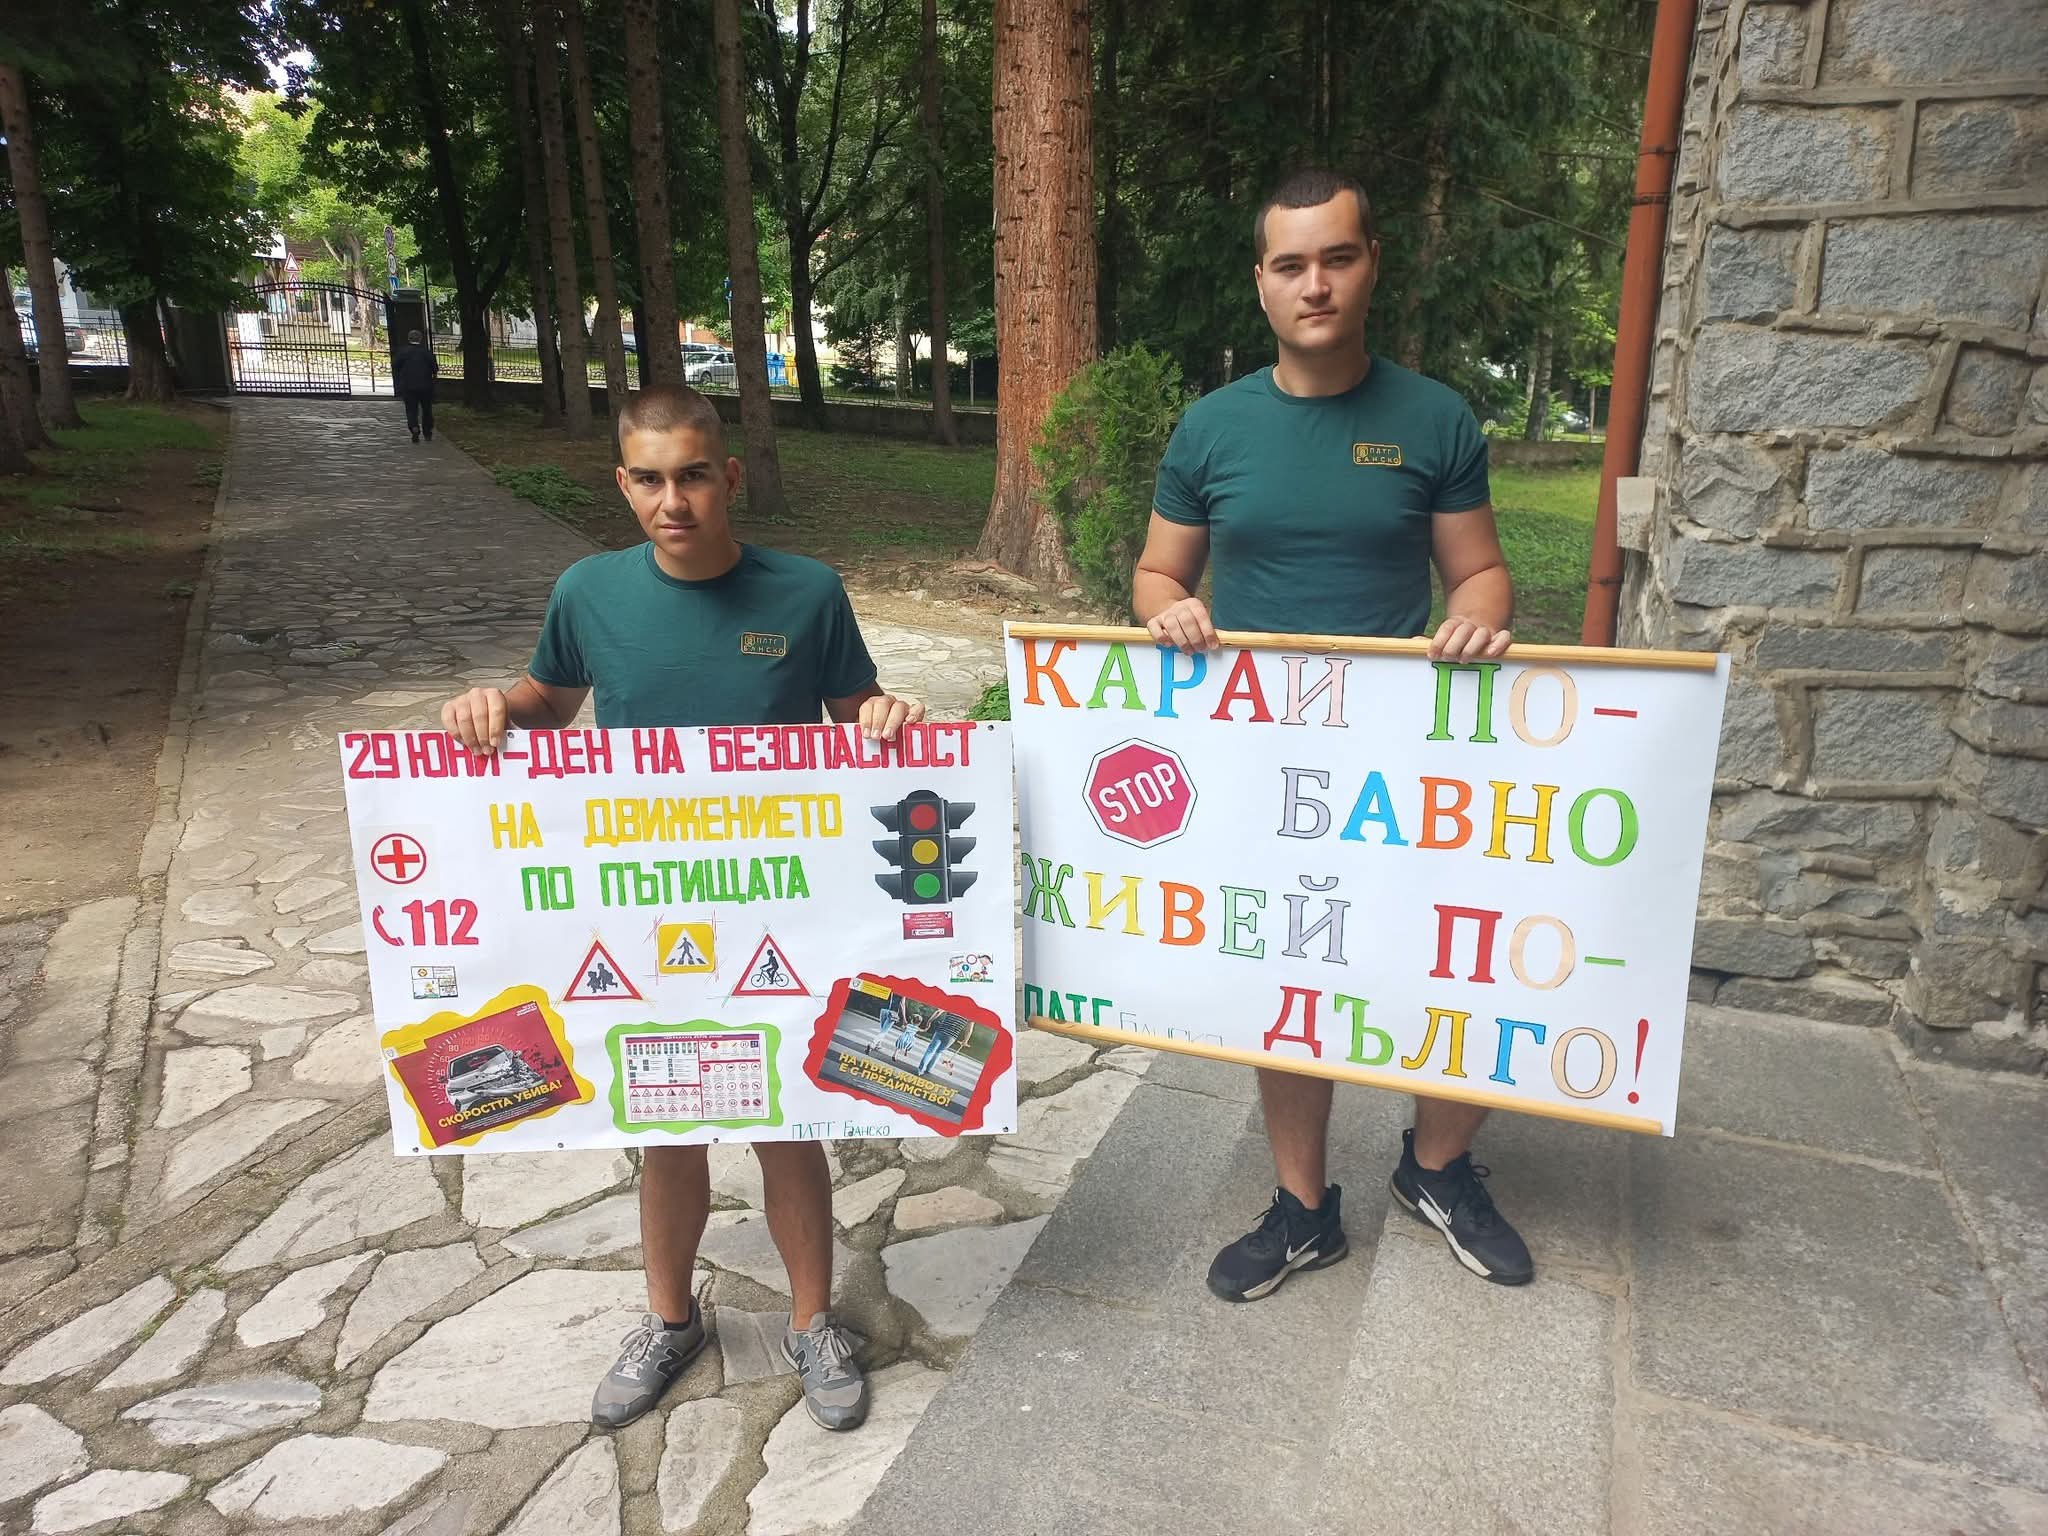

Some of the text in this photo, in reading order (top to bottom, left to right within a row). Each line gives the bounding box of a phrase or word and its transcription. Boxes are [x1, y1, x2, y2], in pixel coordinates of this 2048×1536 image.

[1356, 456, 1399, 464] БАНСКО
[743, 646, 783, 654] БАНСКО
[344, 733, 400, 779] 29
[632, 728, 685, 775] НА
[707, 721, 977, 773] БЕЗОПАСНОСТ
[488, 793, 843, 849] НА ДВИЖЕНИЕТО
[1098, 762, 1179, 824] STOP
[1276, 766, 1639, 867] БАВНО
[521, 855, 811, 911] ПО ПЪТИЩАТА
[1021, 852, 1351, 966] ЖИВЕЙ
[402, 898, 479, 946] 112
[839, 1052, 858, 1067] НА
[1263, 985, 1650, 1106] ДЪЛГО!
[438, 1096, 513, 1128] СКОРОСТТА
[513, 1079, 563, 1105] УБИВА!
[839, 1062, 952, 1107] Е С ПРЕДИМСТВО!
